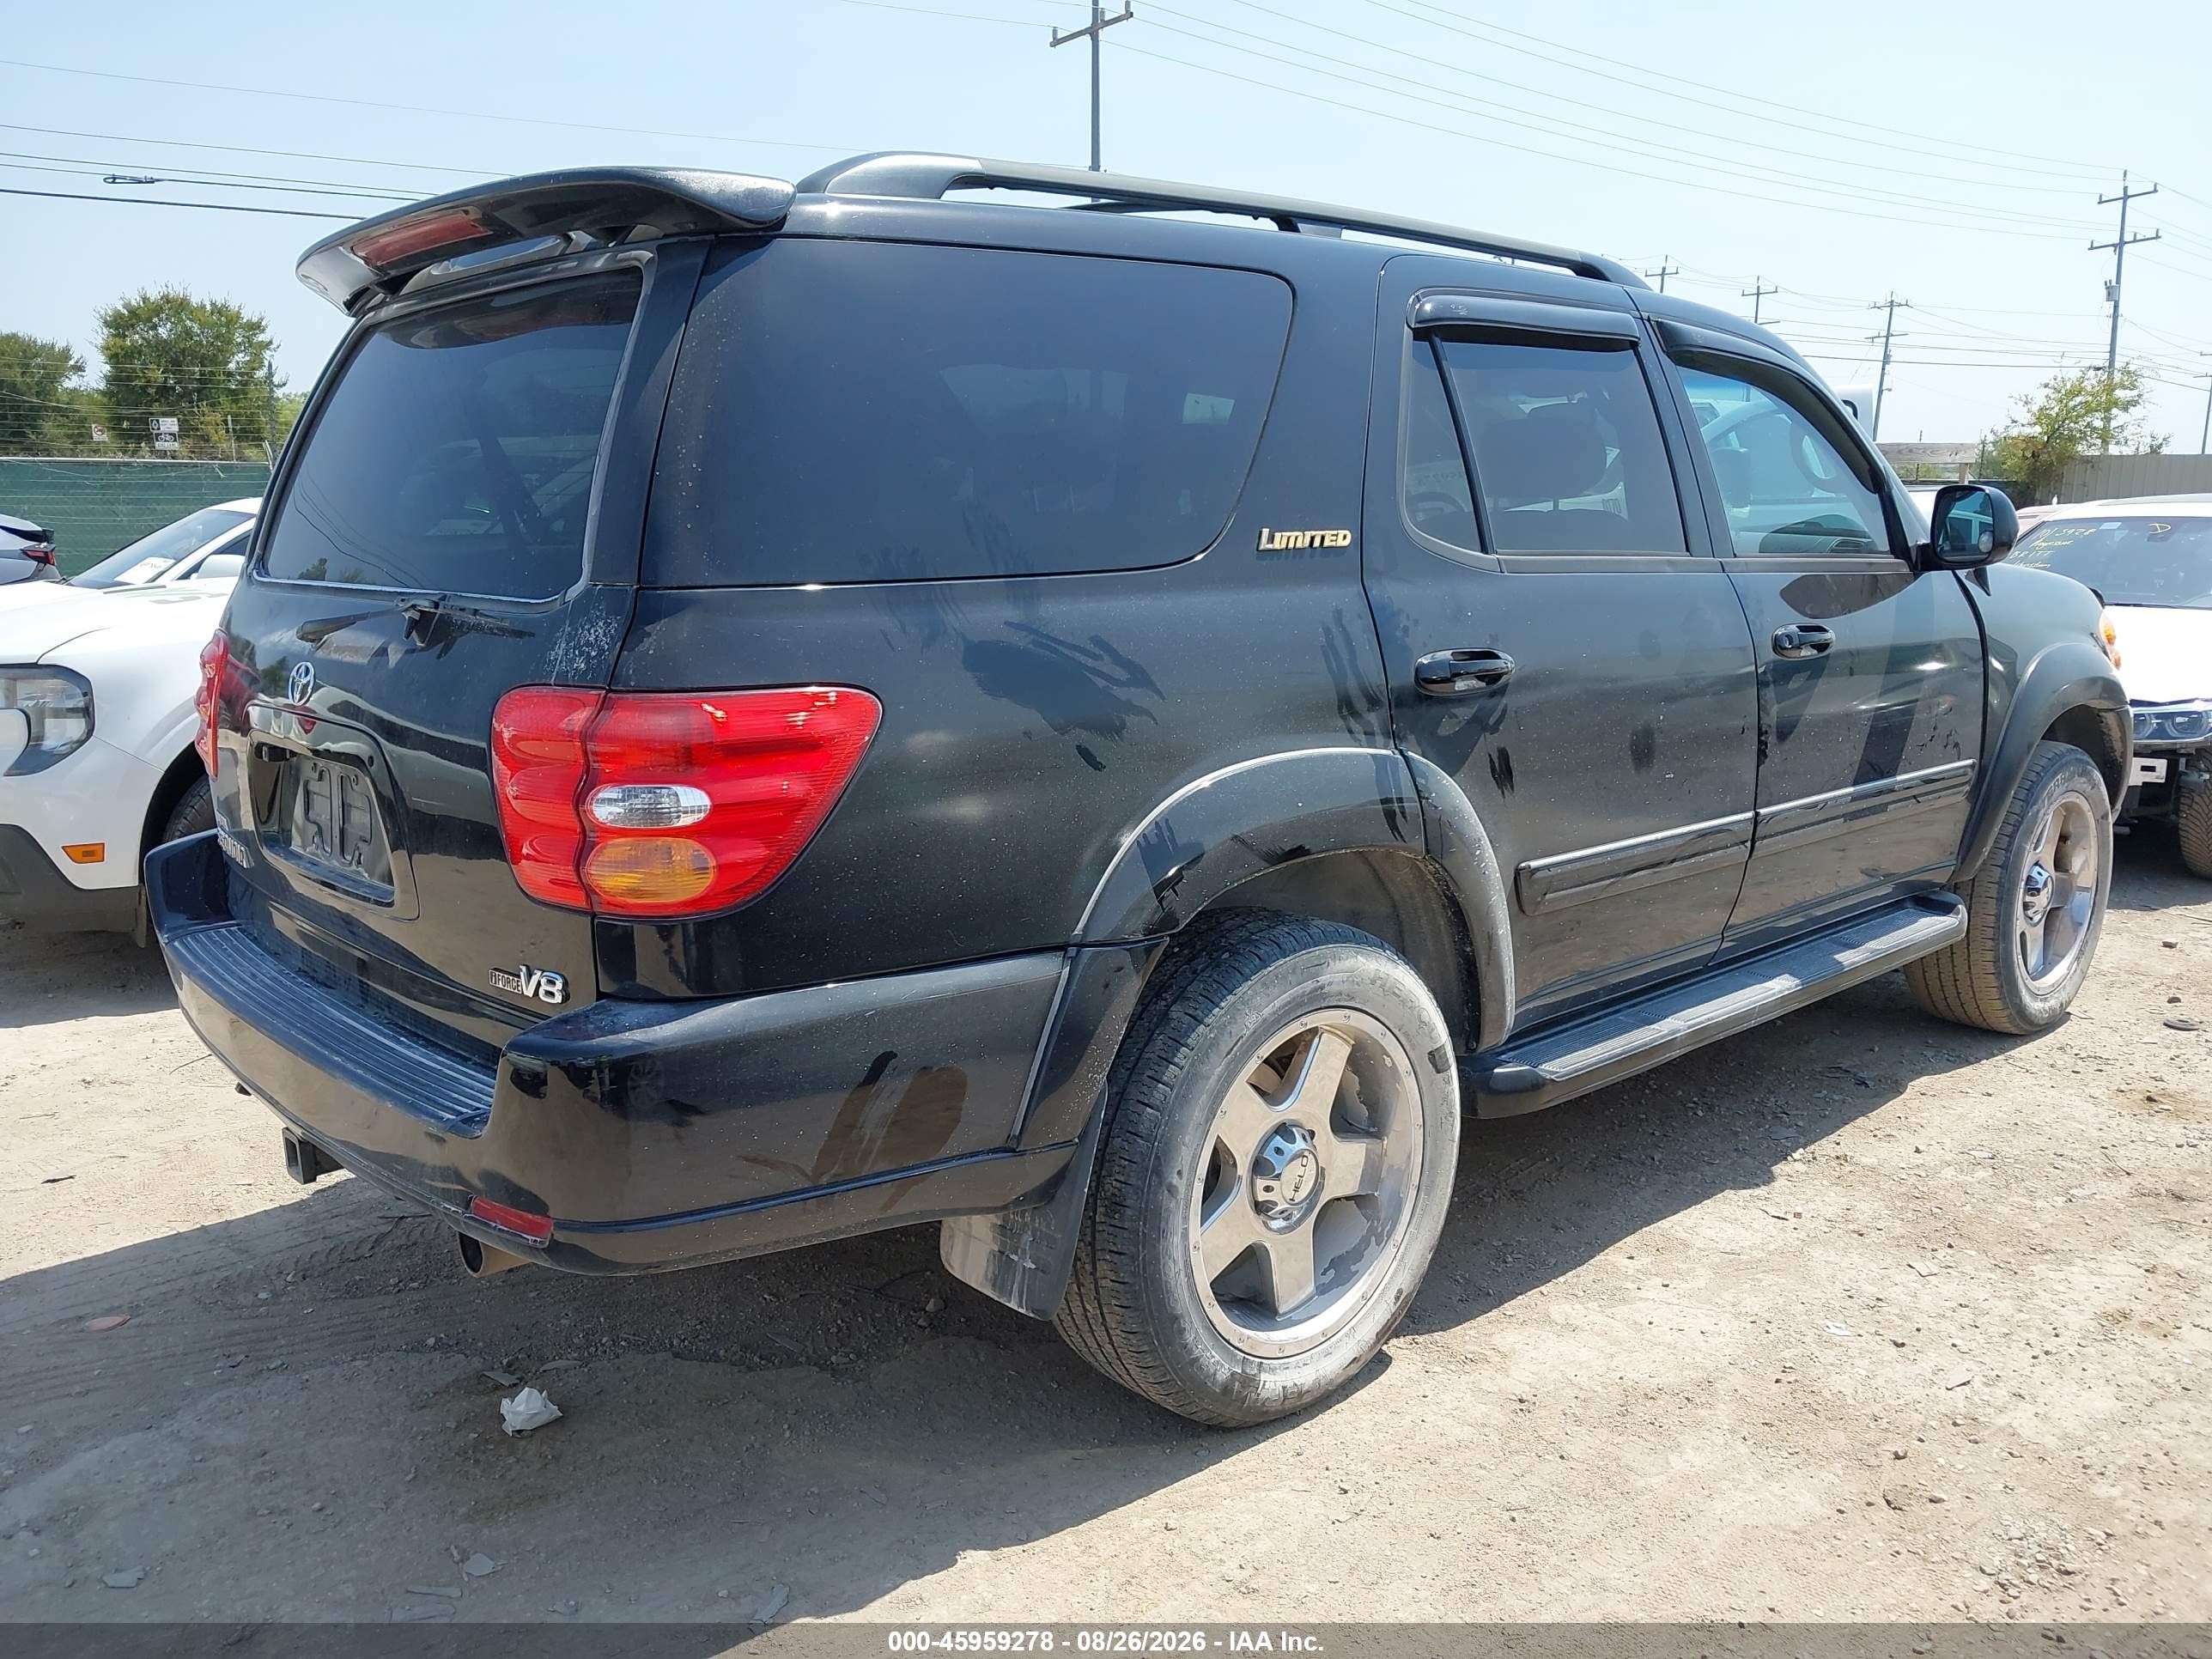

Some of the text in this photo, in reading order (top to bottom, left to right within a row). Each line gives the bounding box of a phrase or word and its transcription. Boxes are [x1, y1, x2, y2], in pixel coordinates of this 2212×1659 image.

[1258, 527, 1352, 550] LIMITED
[519, 964, 564, 1004] V8
[1289, 1155, 1309, 1202] HELO
